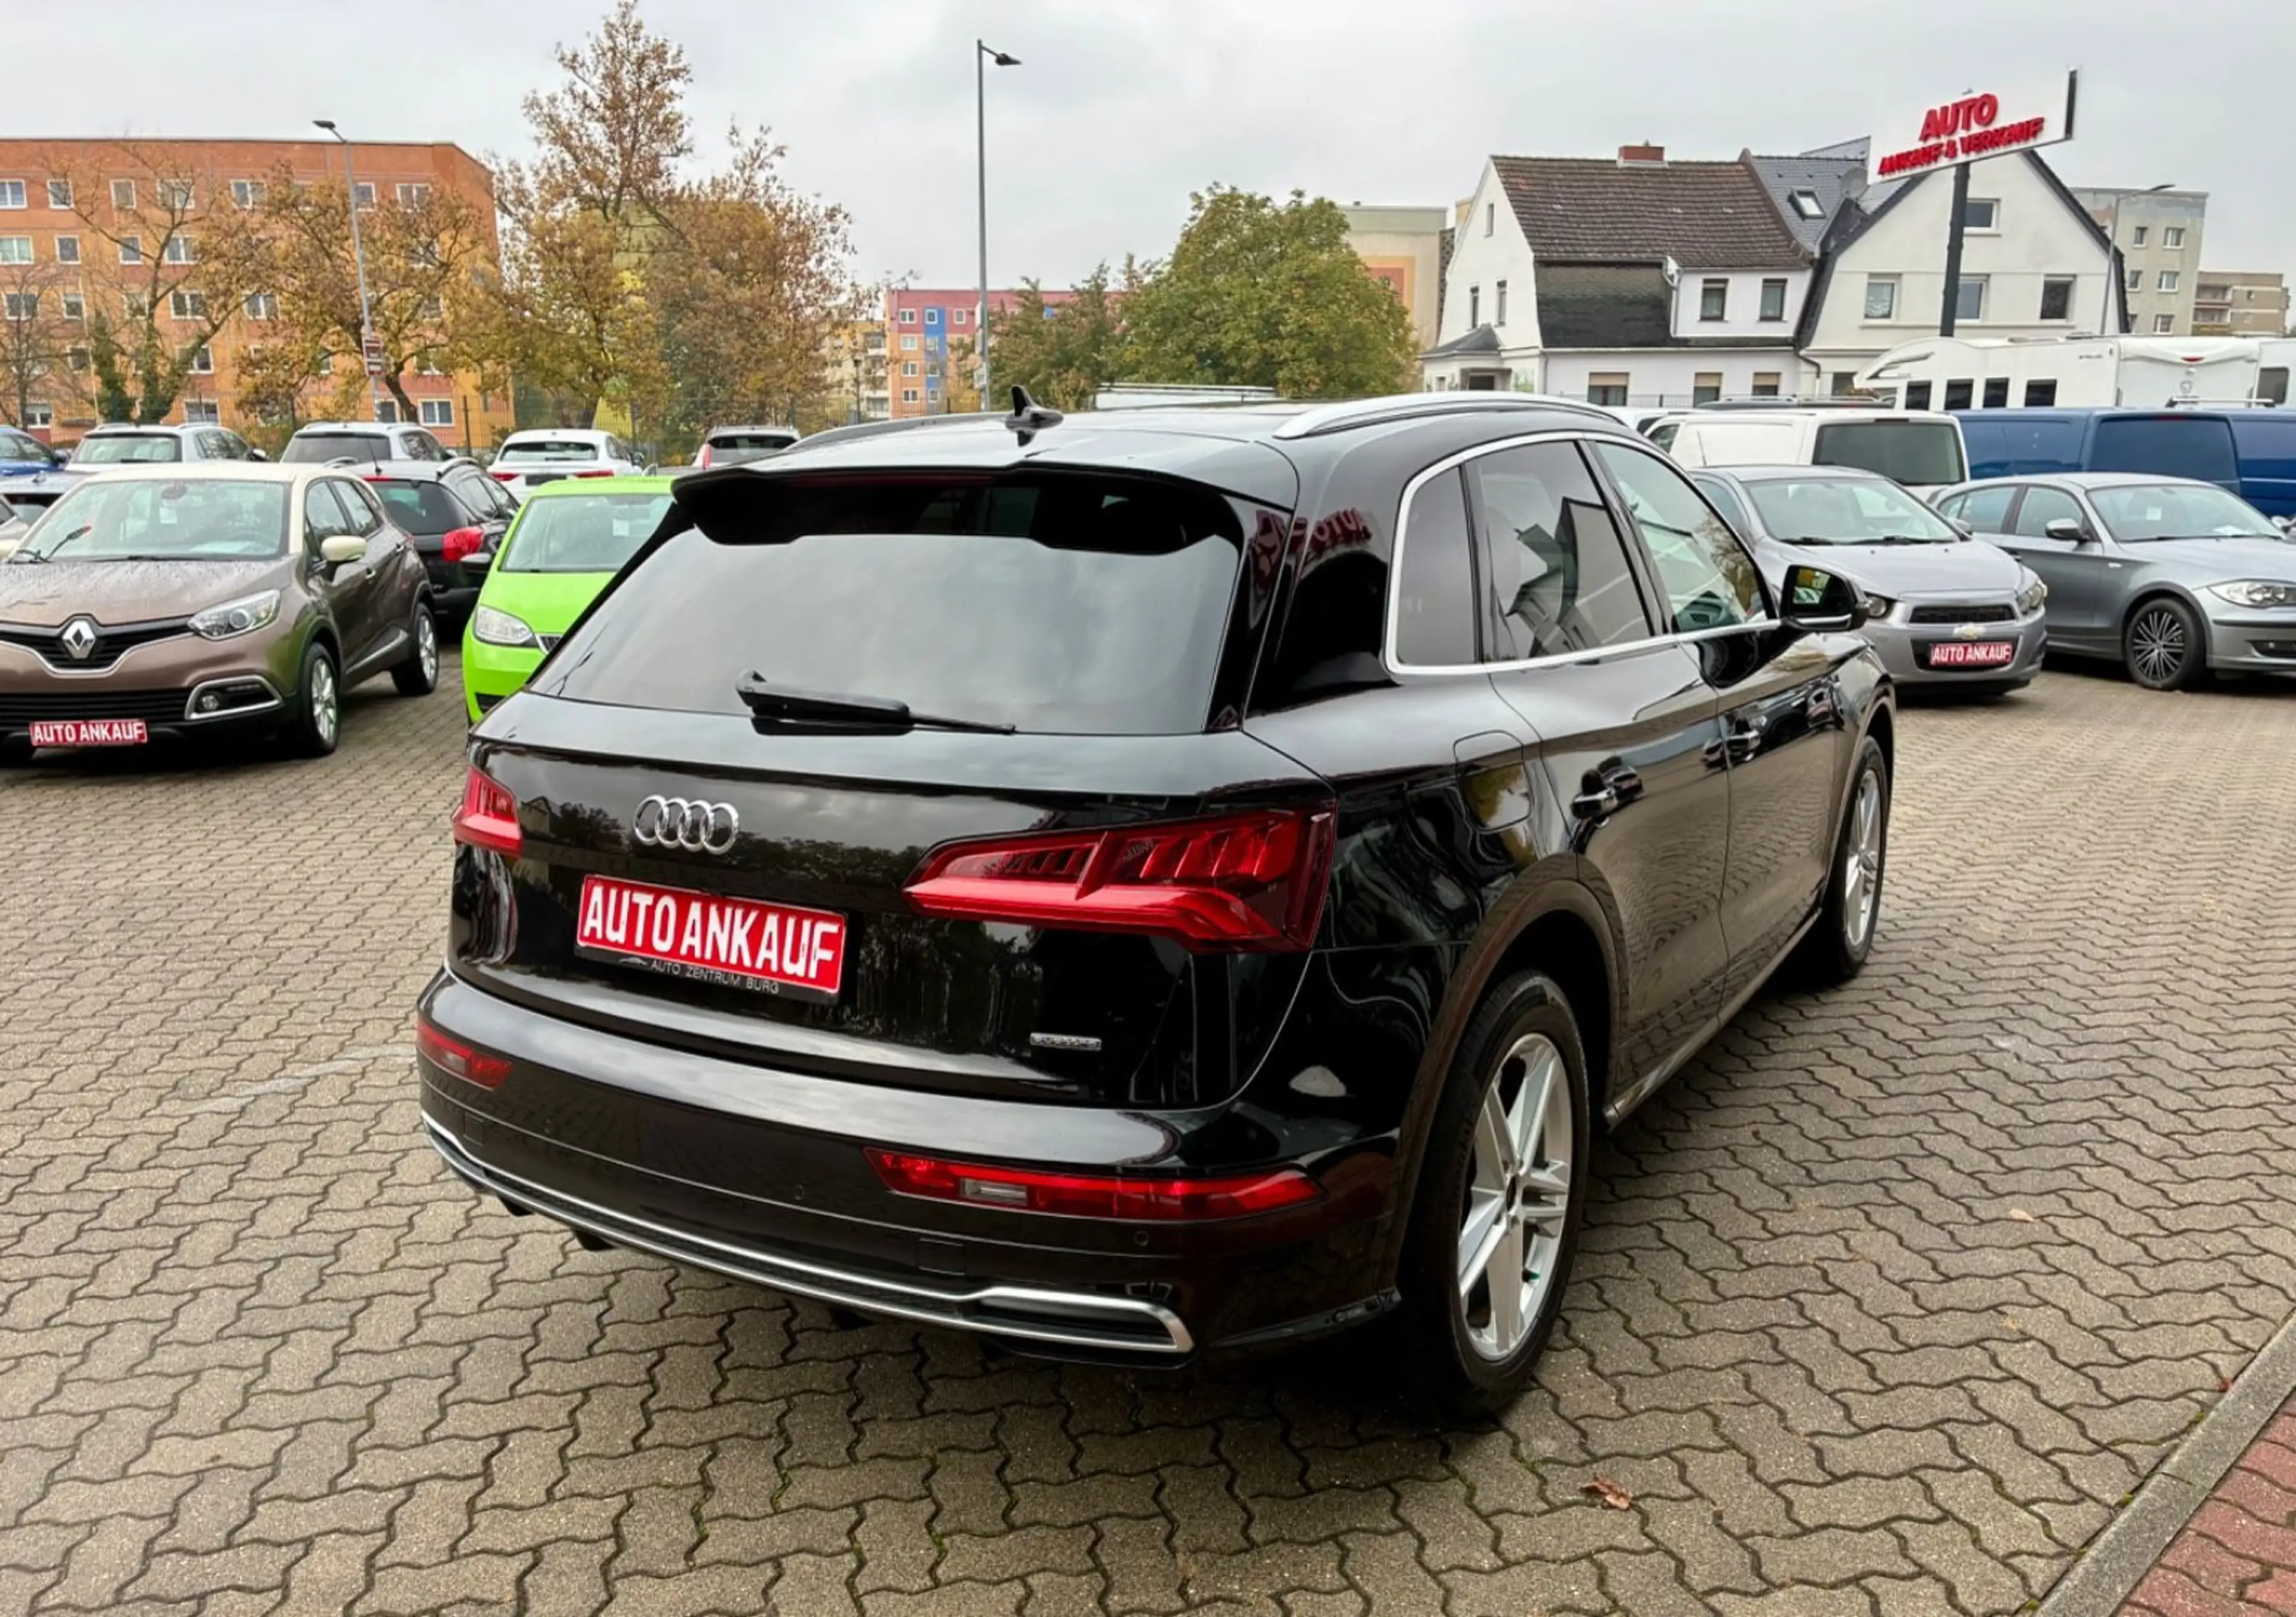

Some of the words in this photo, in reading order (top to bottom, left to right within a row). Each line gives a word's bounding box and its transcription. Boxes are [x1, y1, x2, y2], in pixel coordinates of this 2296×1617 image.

[1919, 93, 1998, 142] AUTO
[1877, 142, 1944, 174] ANKAUF
[1945, 139, 1958, 158] &
[1959, 117, 2045, 154] VERKAUF
[1934, 646, 1964, 662] AUTO
[1965, 644, 2011, 661] ANKAUF
[34, 724, 77, 742] AUTO
[80, 722, 144, 741] ANKAUF
[583, 885, 677, 952] AUTO
[679, 901, 840, 979] ANKAUF
[649, 960, 681, 975] AUTO
[686, 966, 741, 987] ZENTRUM
[746, 977, 780, 994] BURG
